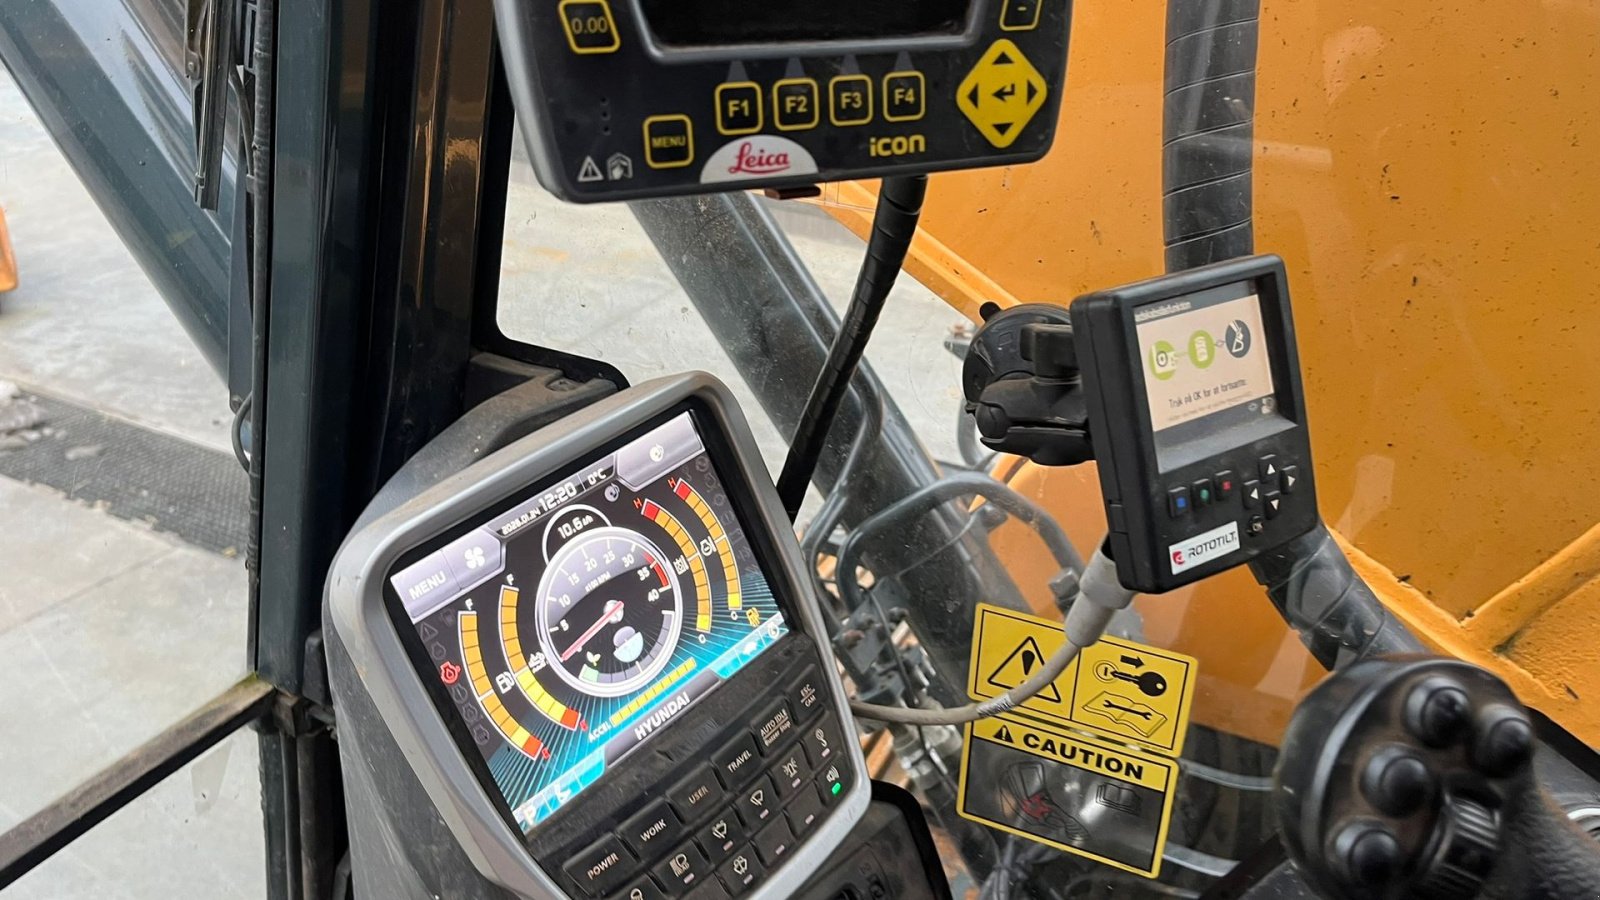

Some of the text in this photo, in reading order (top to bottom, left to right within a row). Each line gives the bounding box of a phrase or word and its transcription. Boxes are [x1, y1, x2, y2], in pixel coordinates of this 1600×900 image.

[571, 17, 609, 34] 0.00
[727, 88, 915, 118] F1 F2 F3 F4
[652, 135, 686, 148] MENU
[728, 142, 790, 174] Leica
[539, 482, 577, 512] 12:20
[587, 468, 606, 485] 0°C
[667, 476, 677, 489] H
[633, 497, 643, 509] H
[1188, 531, 1236, 558] ROTOTILT
[584, 557, 598, 572] 20
[603, 550, 616, 564] 25
[622, 554, 635, 567] 30
[567, 571, 580, 586] 15
[637, 567, 650, 581] 35
[408, 571, 446, 600] MENU
[558, 594, 571, 608] 10
[647, 588, 660, 602] 40
[560, 619, 570, 631] 5
[800, 684, 812, 697] ESC
[804, 694, 817, 707] CAM
[634, 691, 691, 740] HYUNDAI
[760, 708, 788, 738] AUTO IDLE
[588, 721, 613, 743] ACCEL
[727, 749, 752, 773] TRAVEL
[1022, 733, 1144, 780] CAUTION
[688, 785, 709, 804] USER
[640, 818, 667, 842] WORK
[587, 852, 619, 880] POWER
